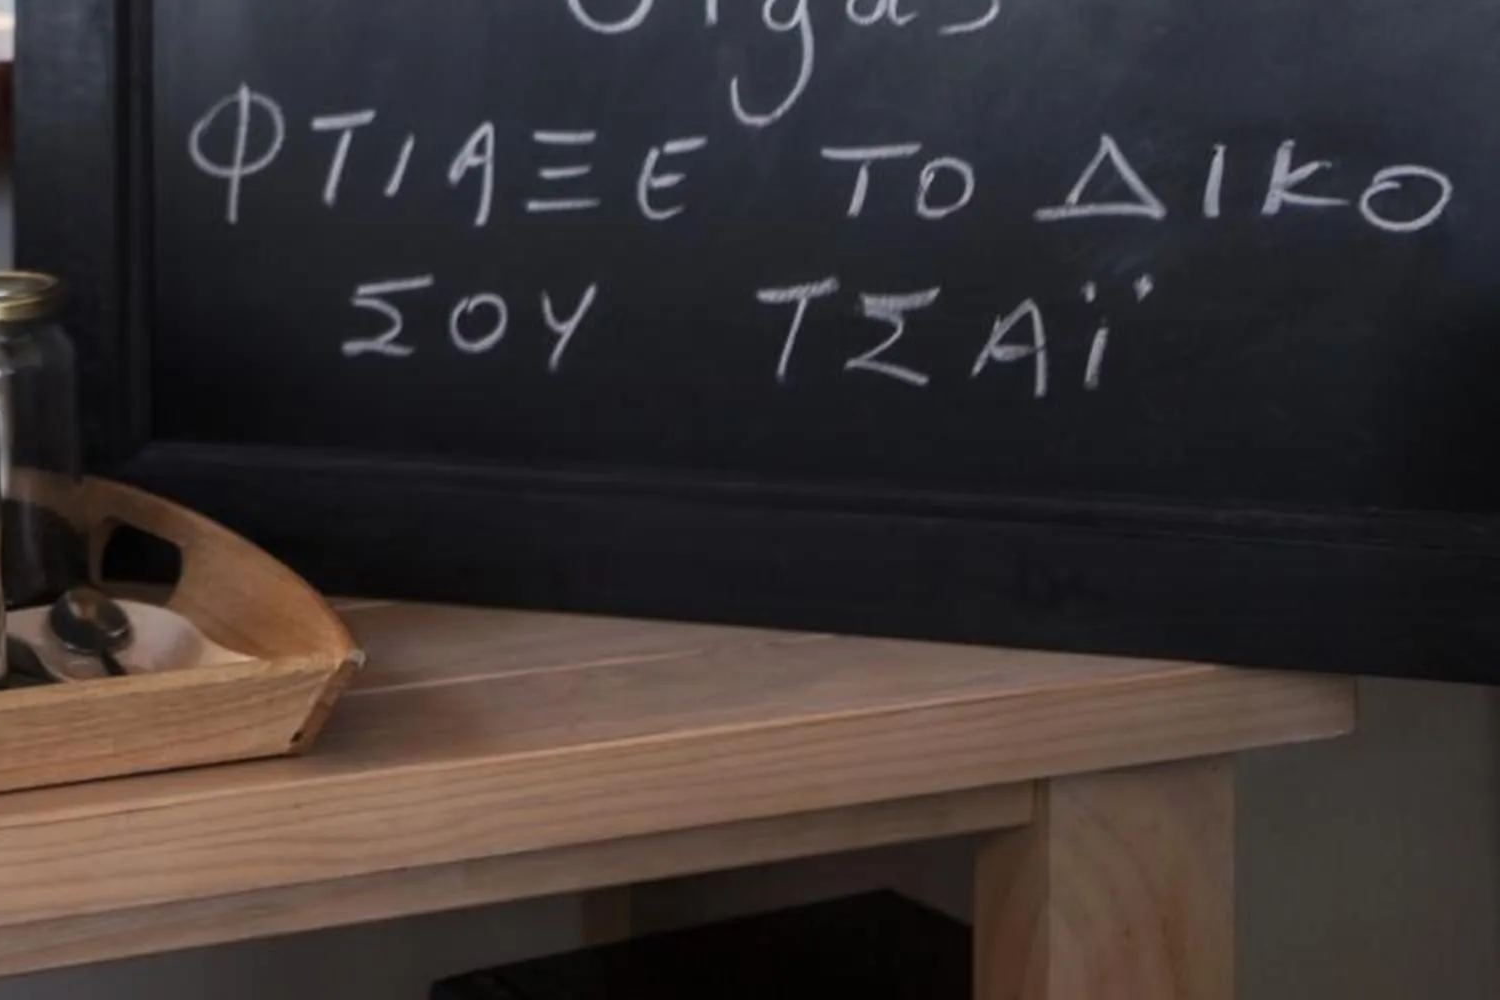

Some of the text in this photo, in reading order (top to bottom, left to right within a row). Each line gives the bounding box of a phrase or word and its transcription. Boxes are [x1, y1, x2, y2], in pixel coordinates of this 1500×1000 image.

[187, 83, 1454, 234] ΦΤΙΑΞΕ ΤΟ ΔΙΚΟ
[340, 274, 598, 371] ΣΟΥ
